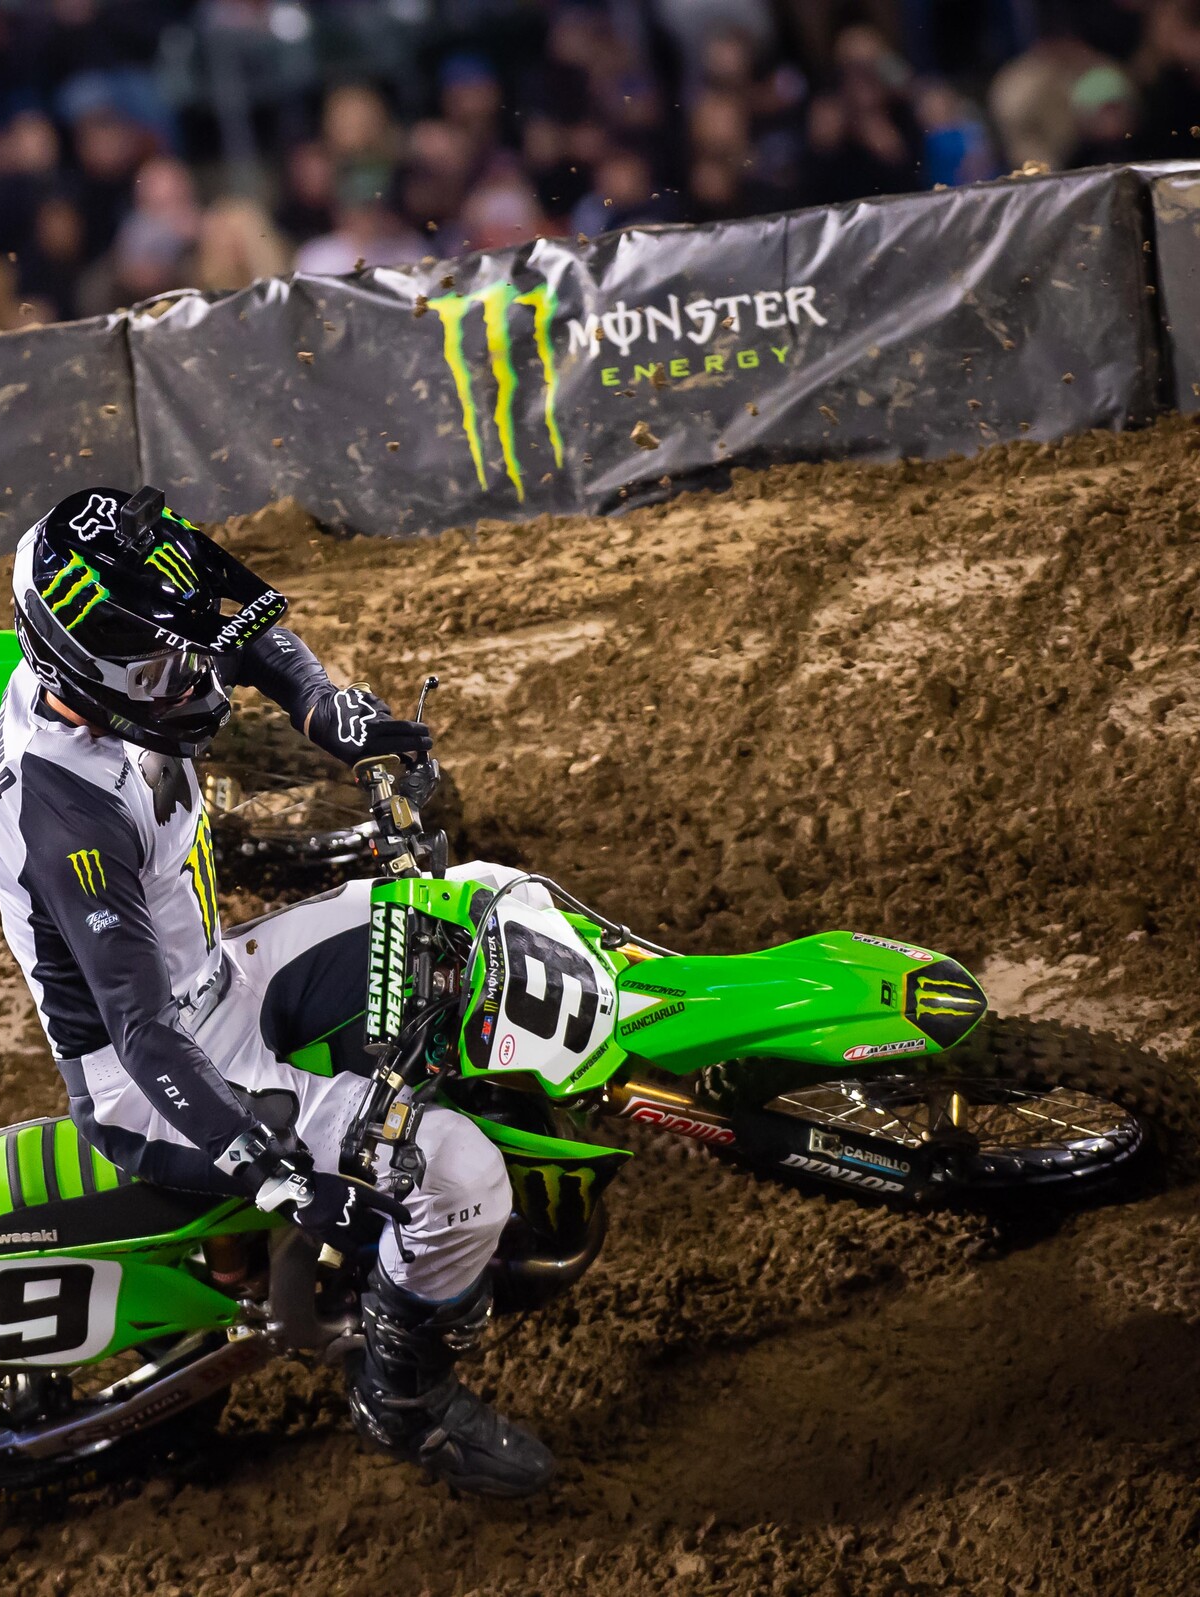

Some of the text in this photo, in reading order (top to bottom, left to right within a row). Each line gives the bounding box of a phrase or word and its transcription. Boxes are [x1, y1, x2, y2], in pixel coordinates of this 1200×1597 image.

[568, 286, 827, 359] MONSTER
[602, 345, 790, 387] ENERGY
[155, 628, 193, 652] FOX
[210, 590, 284, 652] MONSTER
[236, 603, 283, 647] ENERGY
[85, 910, 110, 926] TEAM
[91, 914, 120, 932] GREEN
[366, 901, 387, 1037] RENTHA
[486, 935, 500, 999] MONSTER
[503, 920, 599, 1054] 9
[620, 1001, 685, 1036] CIANCIARULO
[569, 1042, 610, 1084] Kawasaki
[156, 1073, 190, 1111] FOX
[781, 1153, 905, 1192] DUNLOP
[844, 1145, 911, 1173] CARRILLO
[447, 1203, 482, 1227] FOX
